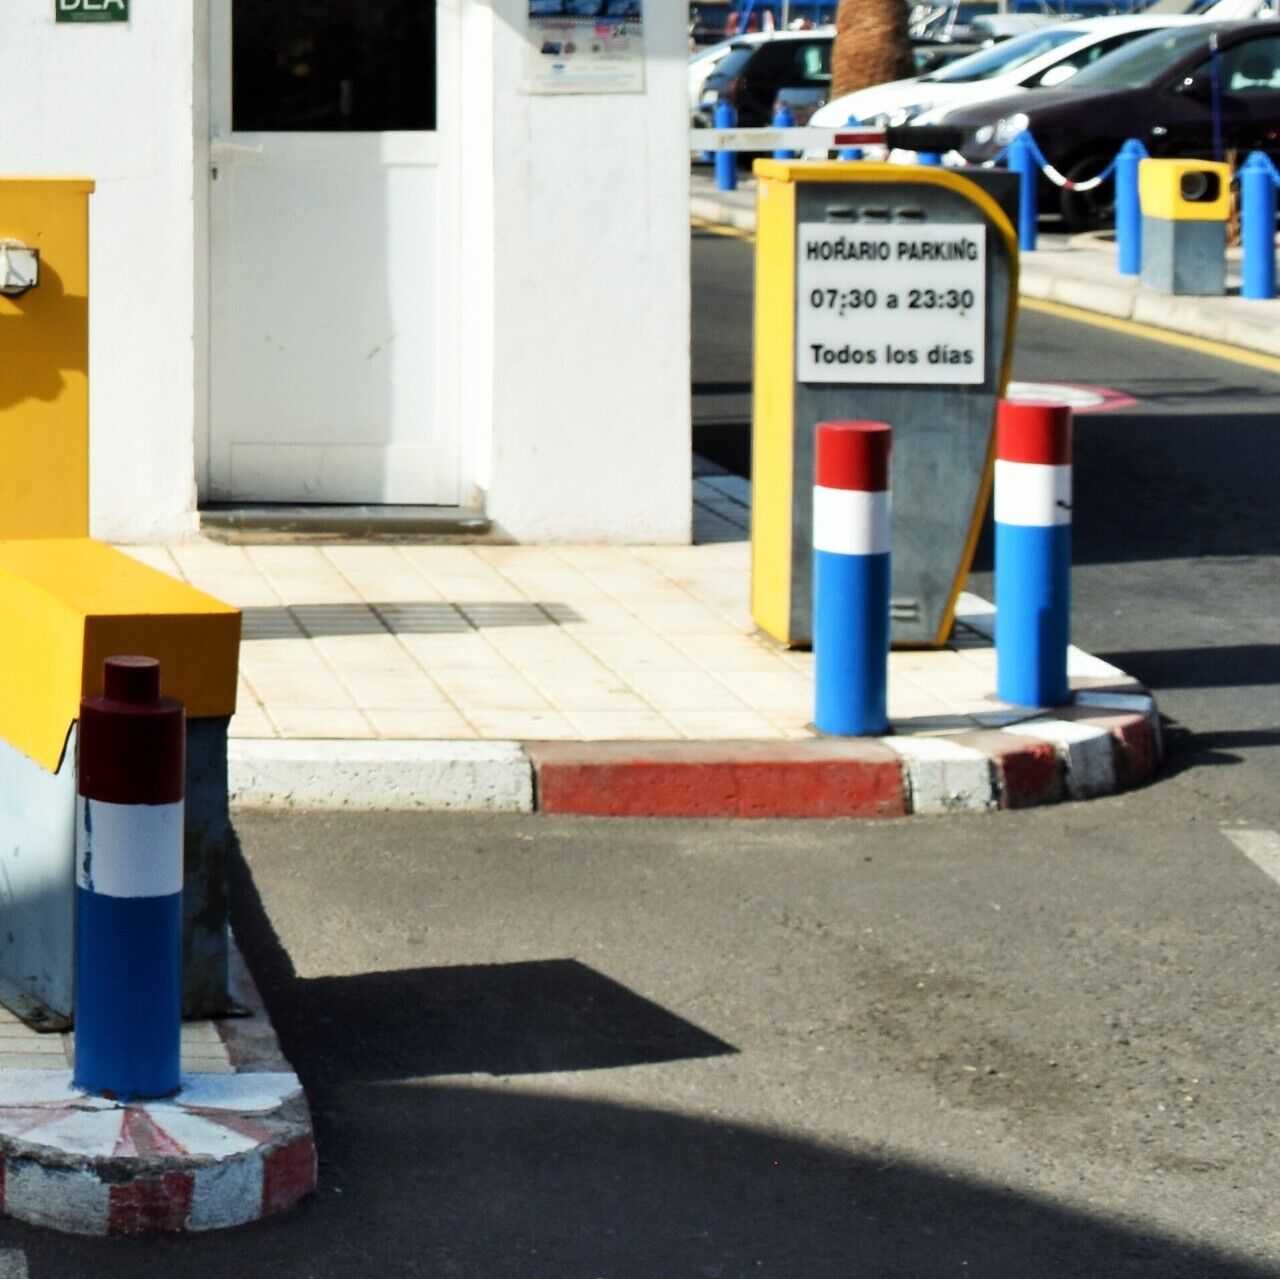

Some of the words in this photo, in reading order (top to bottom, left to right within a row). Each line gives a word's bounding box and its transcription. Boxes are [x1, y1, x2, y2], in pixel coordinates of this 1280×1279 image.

[806, 240, 891, 261] HORARIO
[897, 240, 978, 261] PARKING
[810, 288, 878, 309] 07:30
[886, 292, 899, 309] a
[907, 288, 974, 309] 23:30
[810, 343, 877, 365] Todos
[886, 343, 918, 364] los
